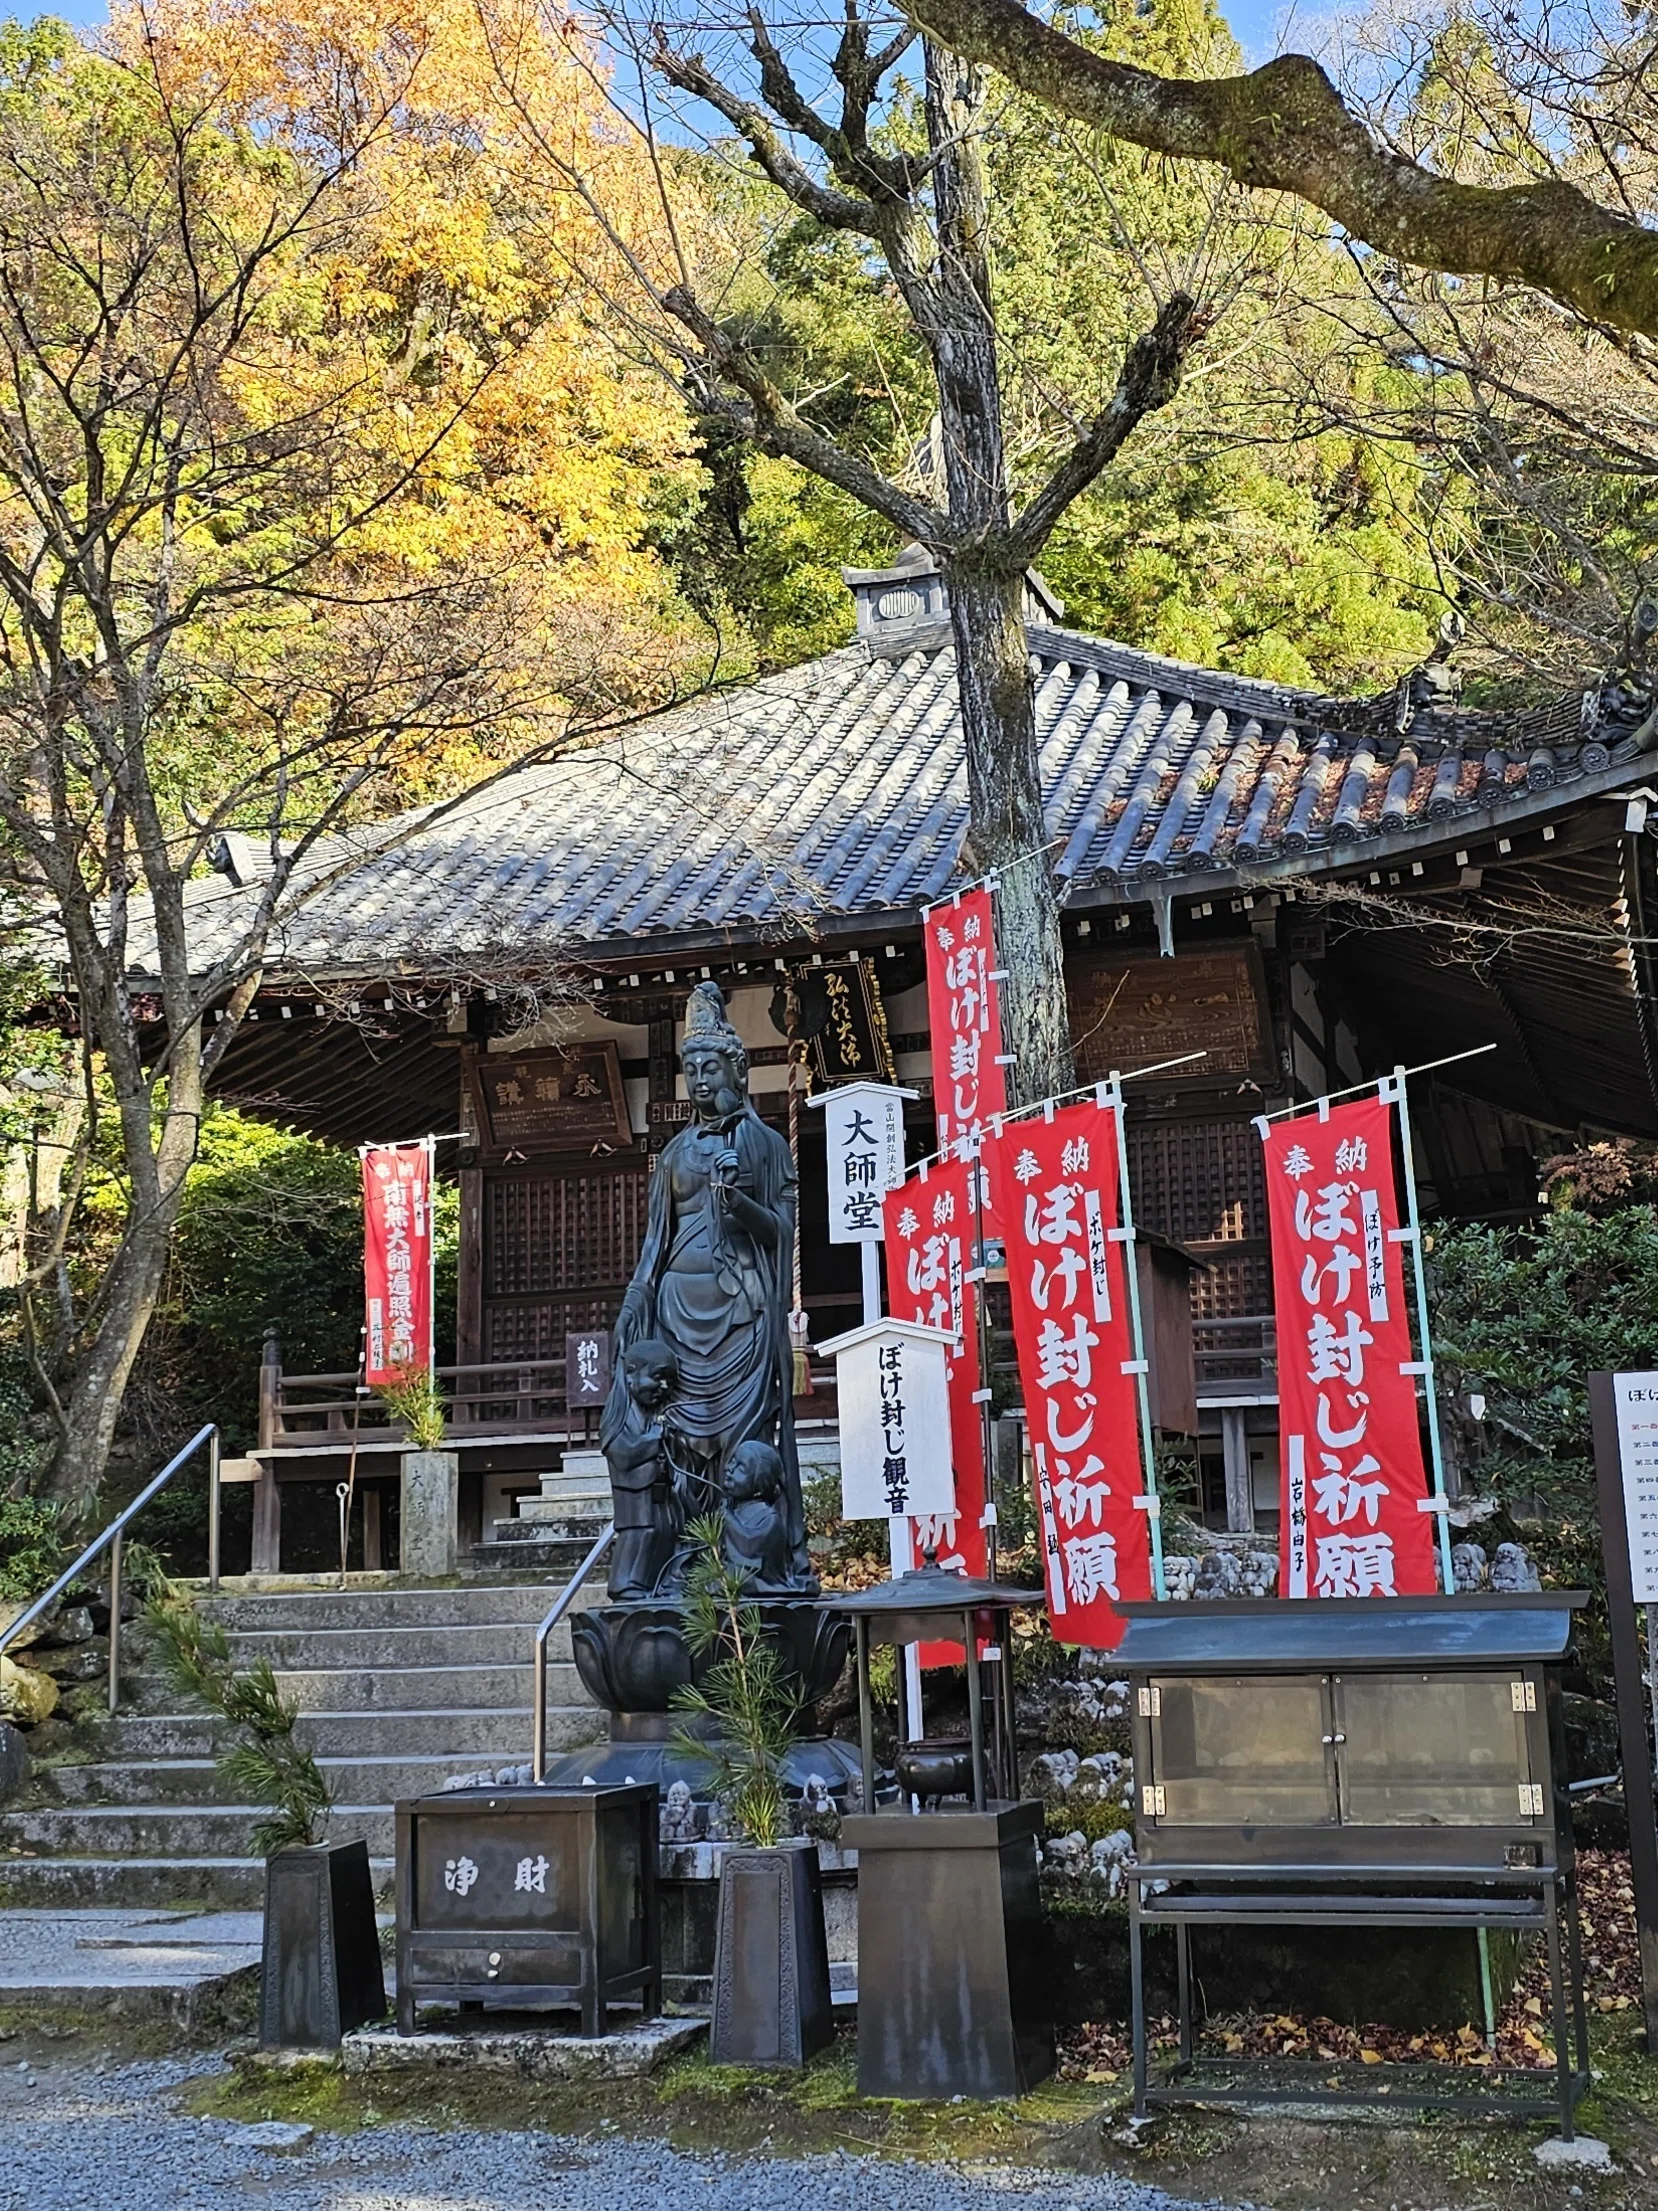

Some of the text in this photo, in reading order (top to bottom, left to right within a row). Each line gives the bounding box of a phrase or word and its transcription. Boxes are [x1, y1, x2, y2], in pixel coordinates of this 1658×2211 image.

[936, 915, 981, 951] 奉納
[841, 1109, 881, 1231] 大師堂
[1013, 1136, 1090, 1186] 奉納
[1283, 1135, 1368, 1181] 奉納
[897, 1190, 955, 1241] 奉納
[1363, 1208, 1386, 1299] ぼけ予防
[577, 1340, 600, 1392] 納札入
[1294, 1181, 1398, 1598] ぼけ封じ祈願
[1024, 1181, 1120, 1606] ぼけ封じ祈願
[879, 1341, 910, 1514] ぼけ封じ観音
[444, 1855, 549, 1896] 浄財
